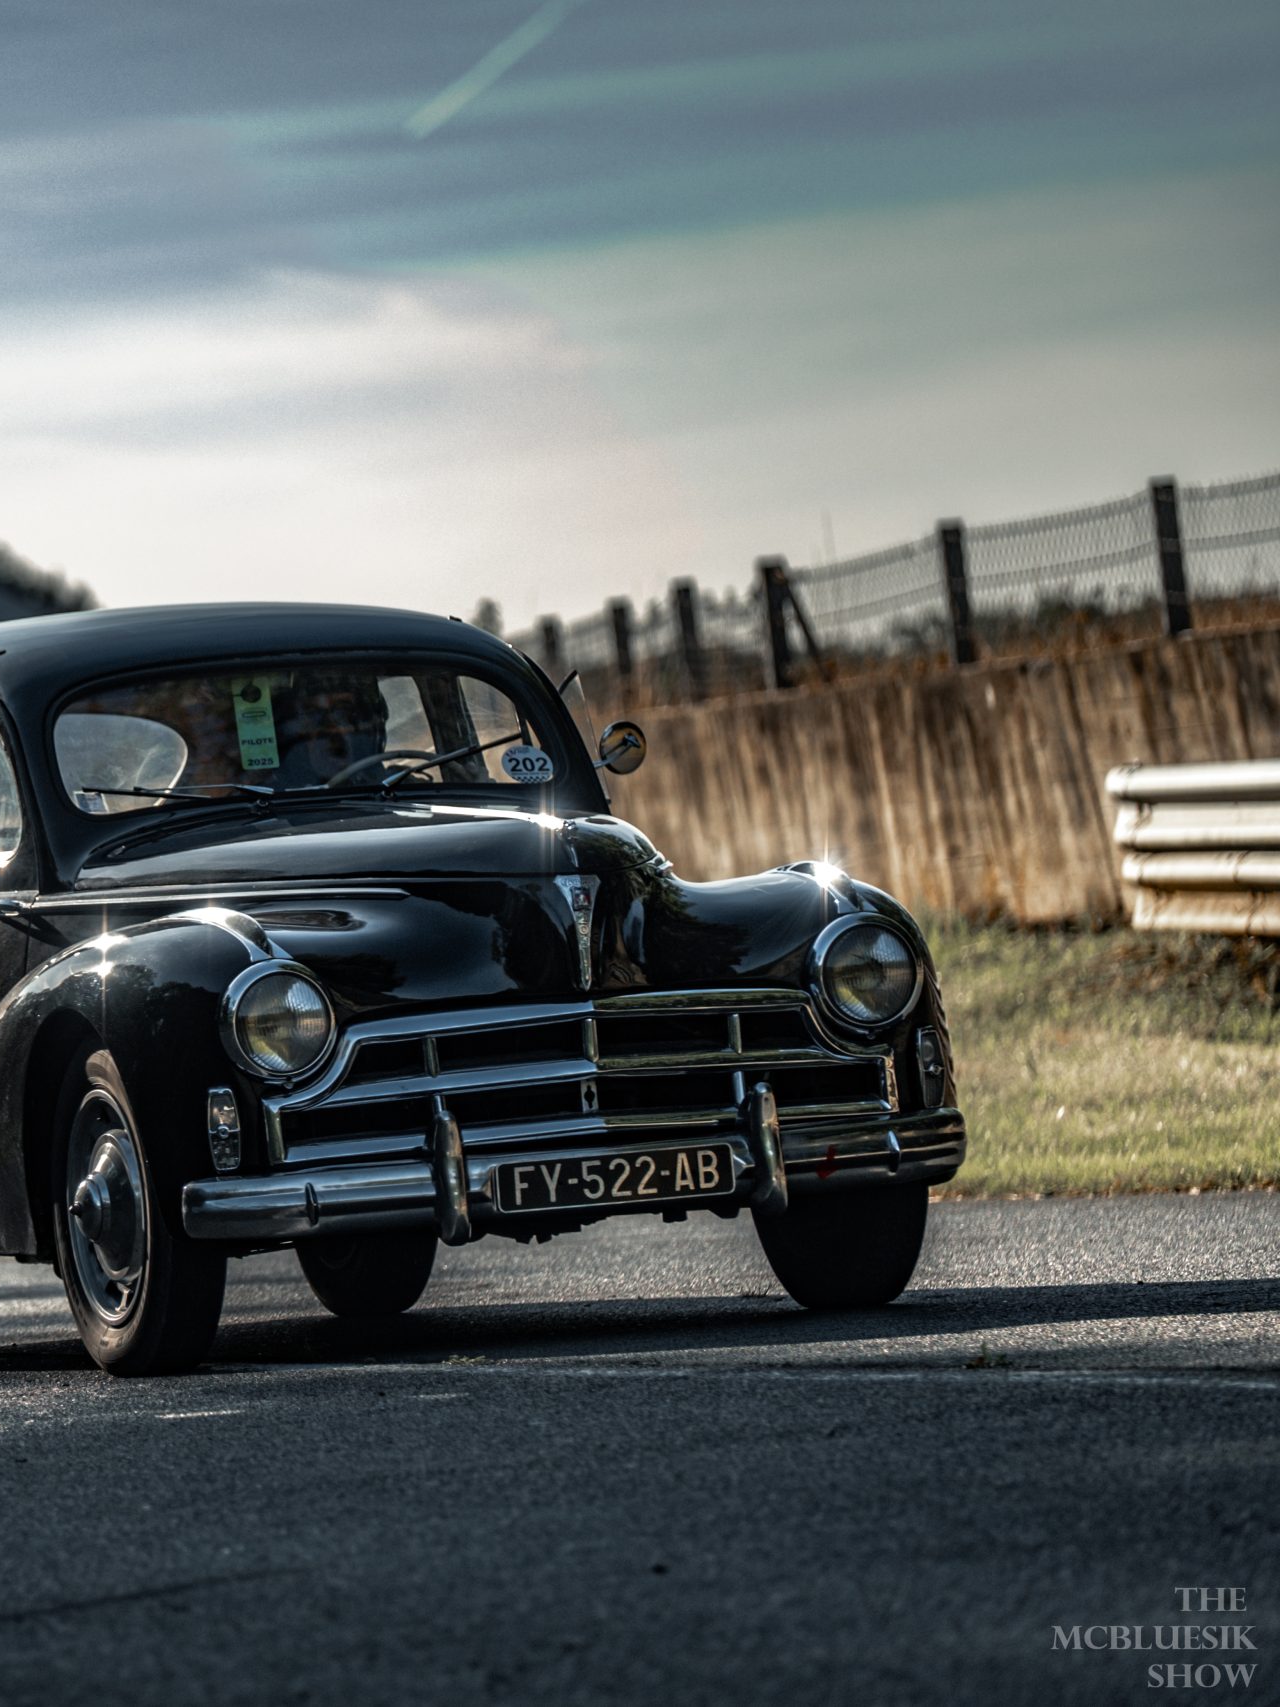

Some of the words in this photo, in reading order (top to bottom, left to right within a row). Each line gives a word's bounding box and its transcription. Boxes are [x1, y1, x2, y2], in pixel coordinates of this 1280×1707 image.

[241, 738, 273, 746] PILOTE
[508, 757, 550, 772] 202
[513, 1150, 720, 1206] FY-522-AB
